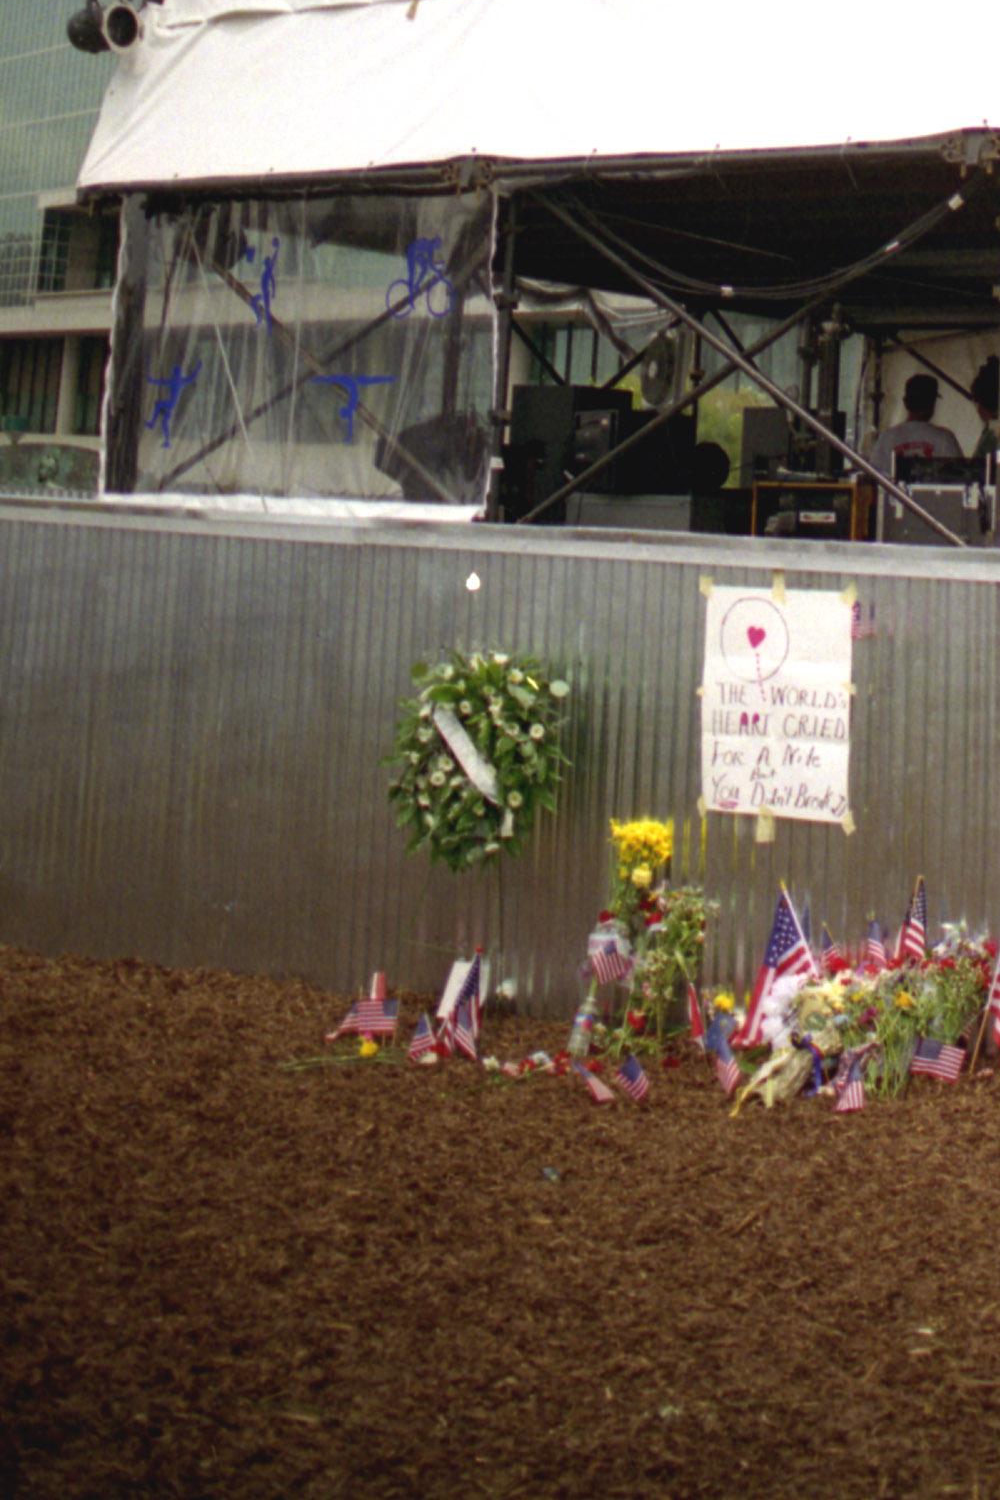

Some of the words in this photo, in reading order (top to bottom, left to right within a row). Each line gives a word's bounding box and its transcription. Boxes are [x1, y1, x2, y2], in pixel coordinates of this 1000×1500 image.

[715, 682, 749, 706] THE
[711, 709, 771, 737] HEART
[783, 713, 846, 741] CRIED
[756, 746, 770, 766] A
